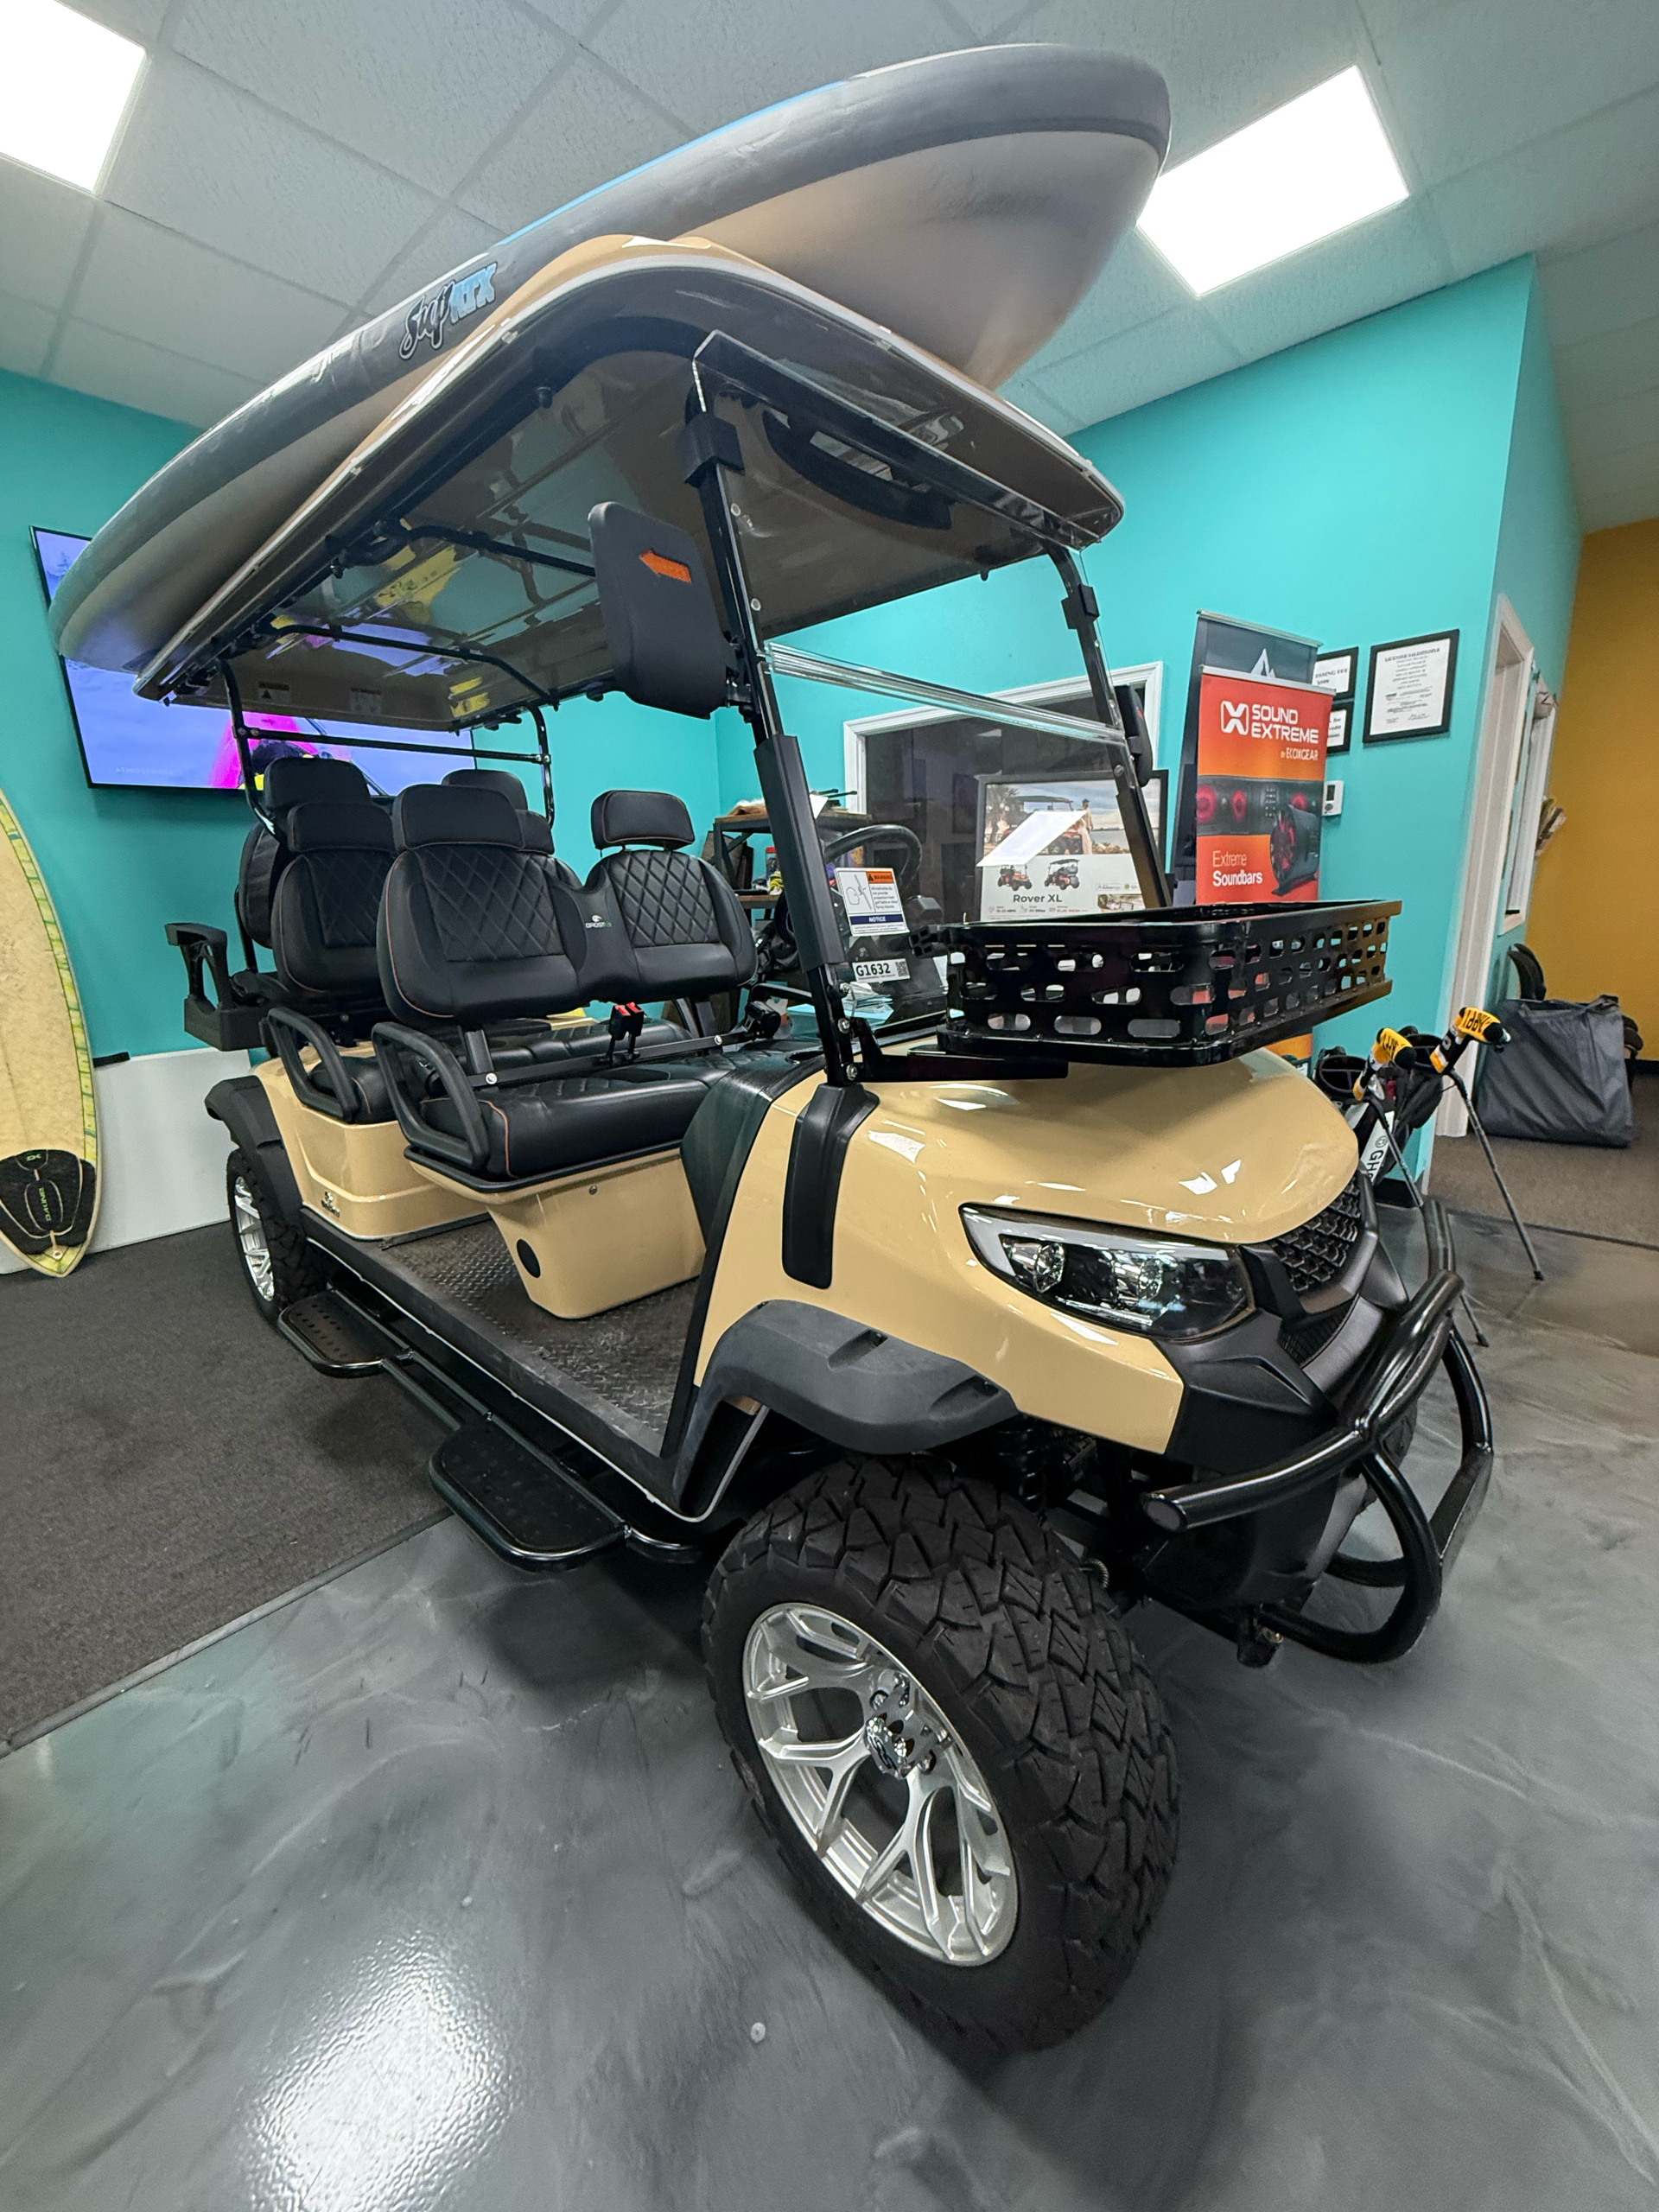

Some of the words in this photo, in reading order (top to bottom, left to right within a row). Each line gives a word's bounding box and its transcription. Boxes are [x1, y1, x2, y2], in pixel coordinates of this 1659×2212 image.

[1315, 670, 1336, 678] ESSING
[1252, 704, 1298, 725] SOUND
[1251, 722, 1319, 744] EXTREME
[1286, 747, 1319, 761] ECOXGEAR
[1212, 850, 1247, 868] Extreme
[1212, 869, 1263, 887] Soundbars
[1013, 894, 1045, 903] Rover
[855, 963, 891, 976] G1632
